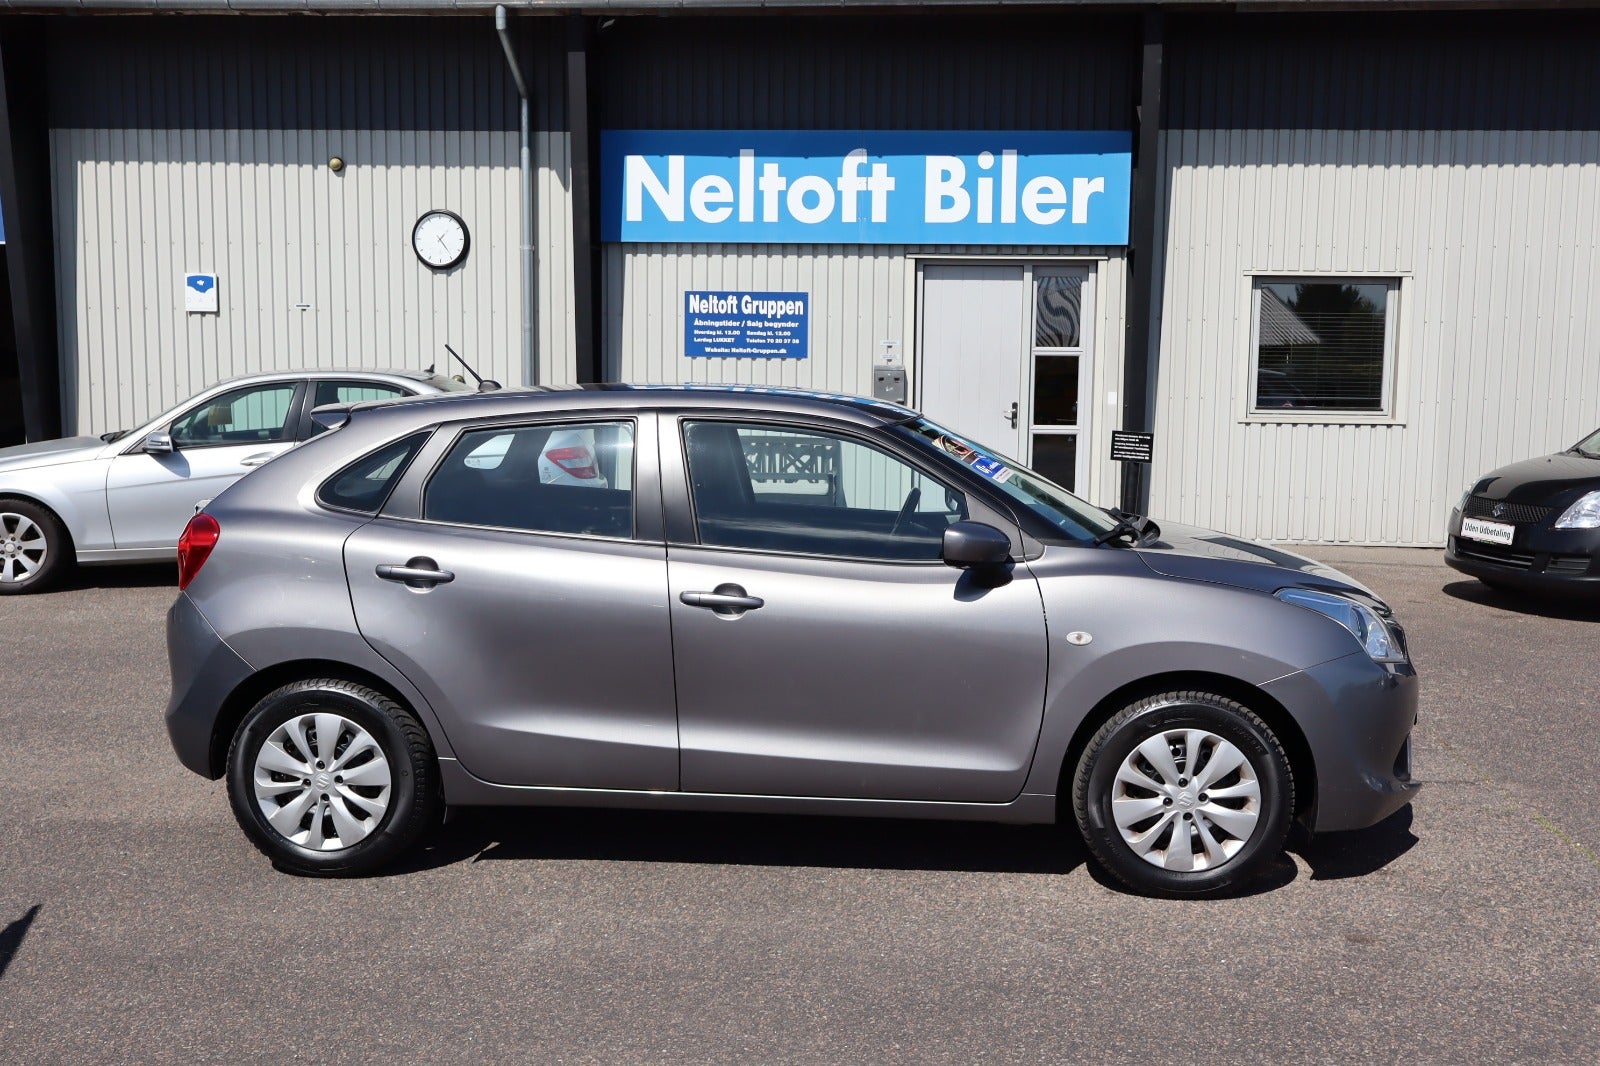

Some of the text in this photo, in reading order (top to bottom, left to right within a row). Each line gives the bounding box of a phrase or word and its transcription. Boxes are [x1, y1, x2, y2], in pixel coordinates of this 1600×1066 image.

[626, 148, 1105, 225] Neltoft Biler
[689, 294, 804, 319] Neltoft Gruppen
[694, 318, 741, 328] Åbningstider
[764, 321, 800, 329] begynder
[1465, 522, 1479, 533] Uden
